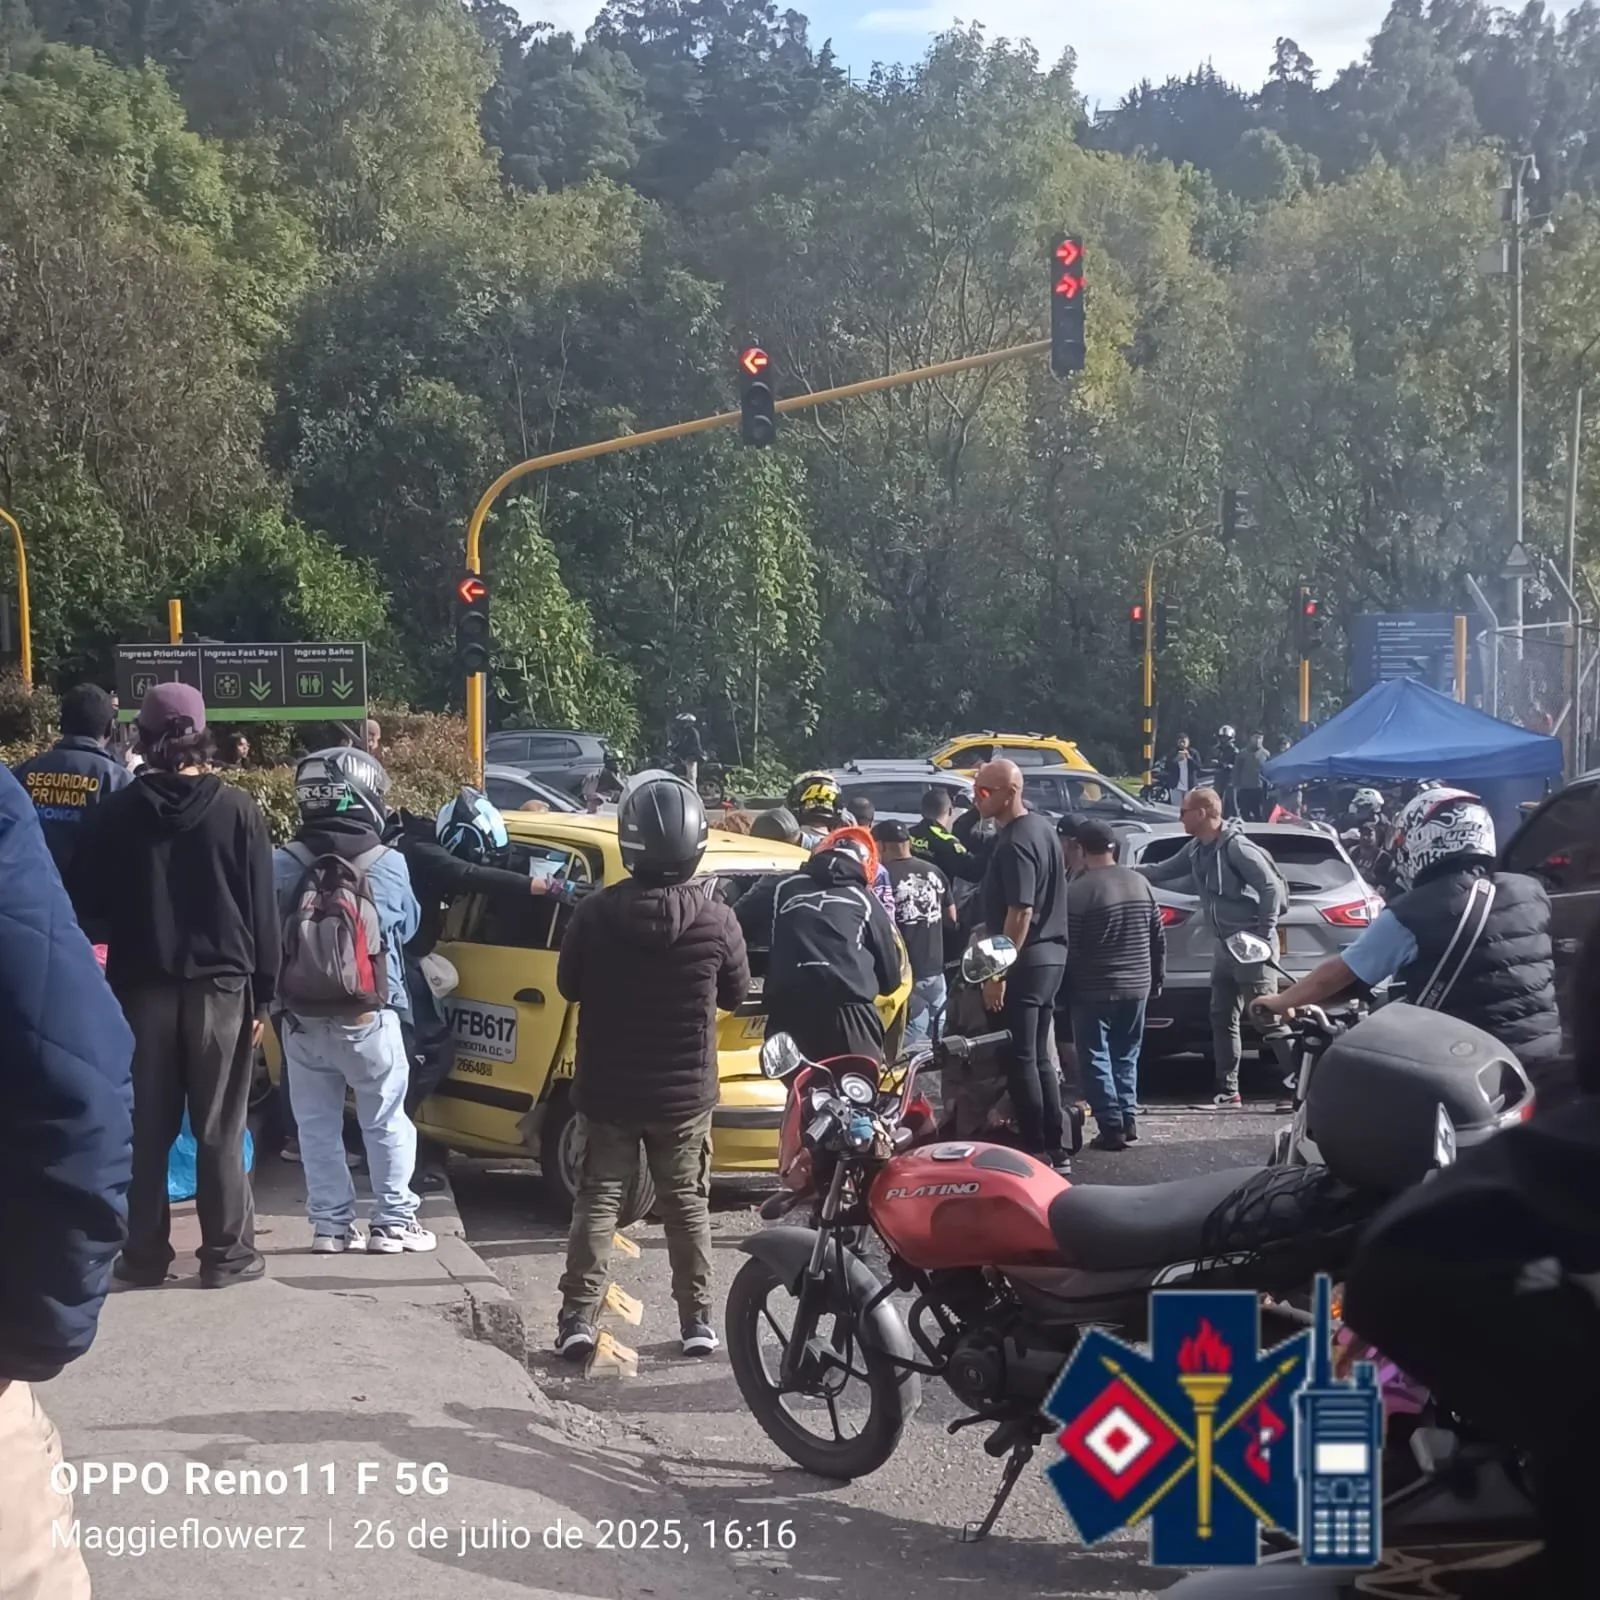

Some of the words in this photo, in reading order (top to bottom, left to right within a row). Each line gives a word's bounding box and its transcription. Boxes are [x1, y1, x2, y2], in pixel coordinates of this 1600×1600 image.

[119, 650, 152, 658] Ingreso
[153, 649, 197, 657] Prioritario
[204, 649, 236, 658] Ingreso
[294, 648, 327, 657] Ingreso
[26, 772, 99, 791] SEGURIDAD
[31, 787, 87, 806] PRIVADA
[444, 1006, 517, 1042] VFB617
[885, 1182, 980, 1200] PLATINO
